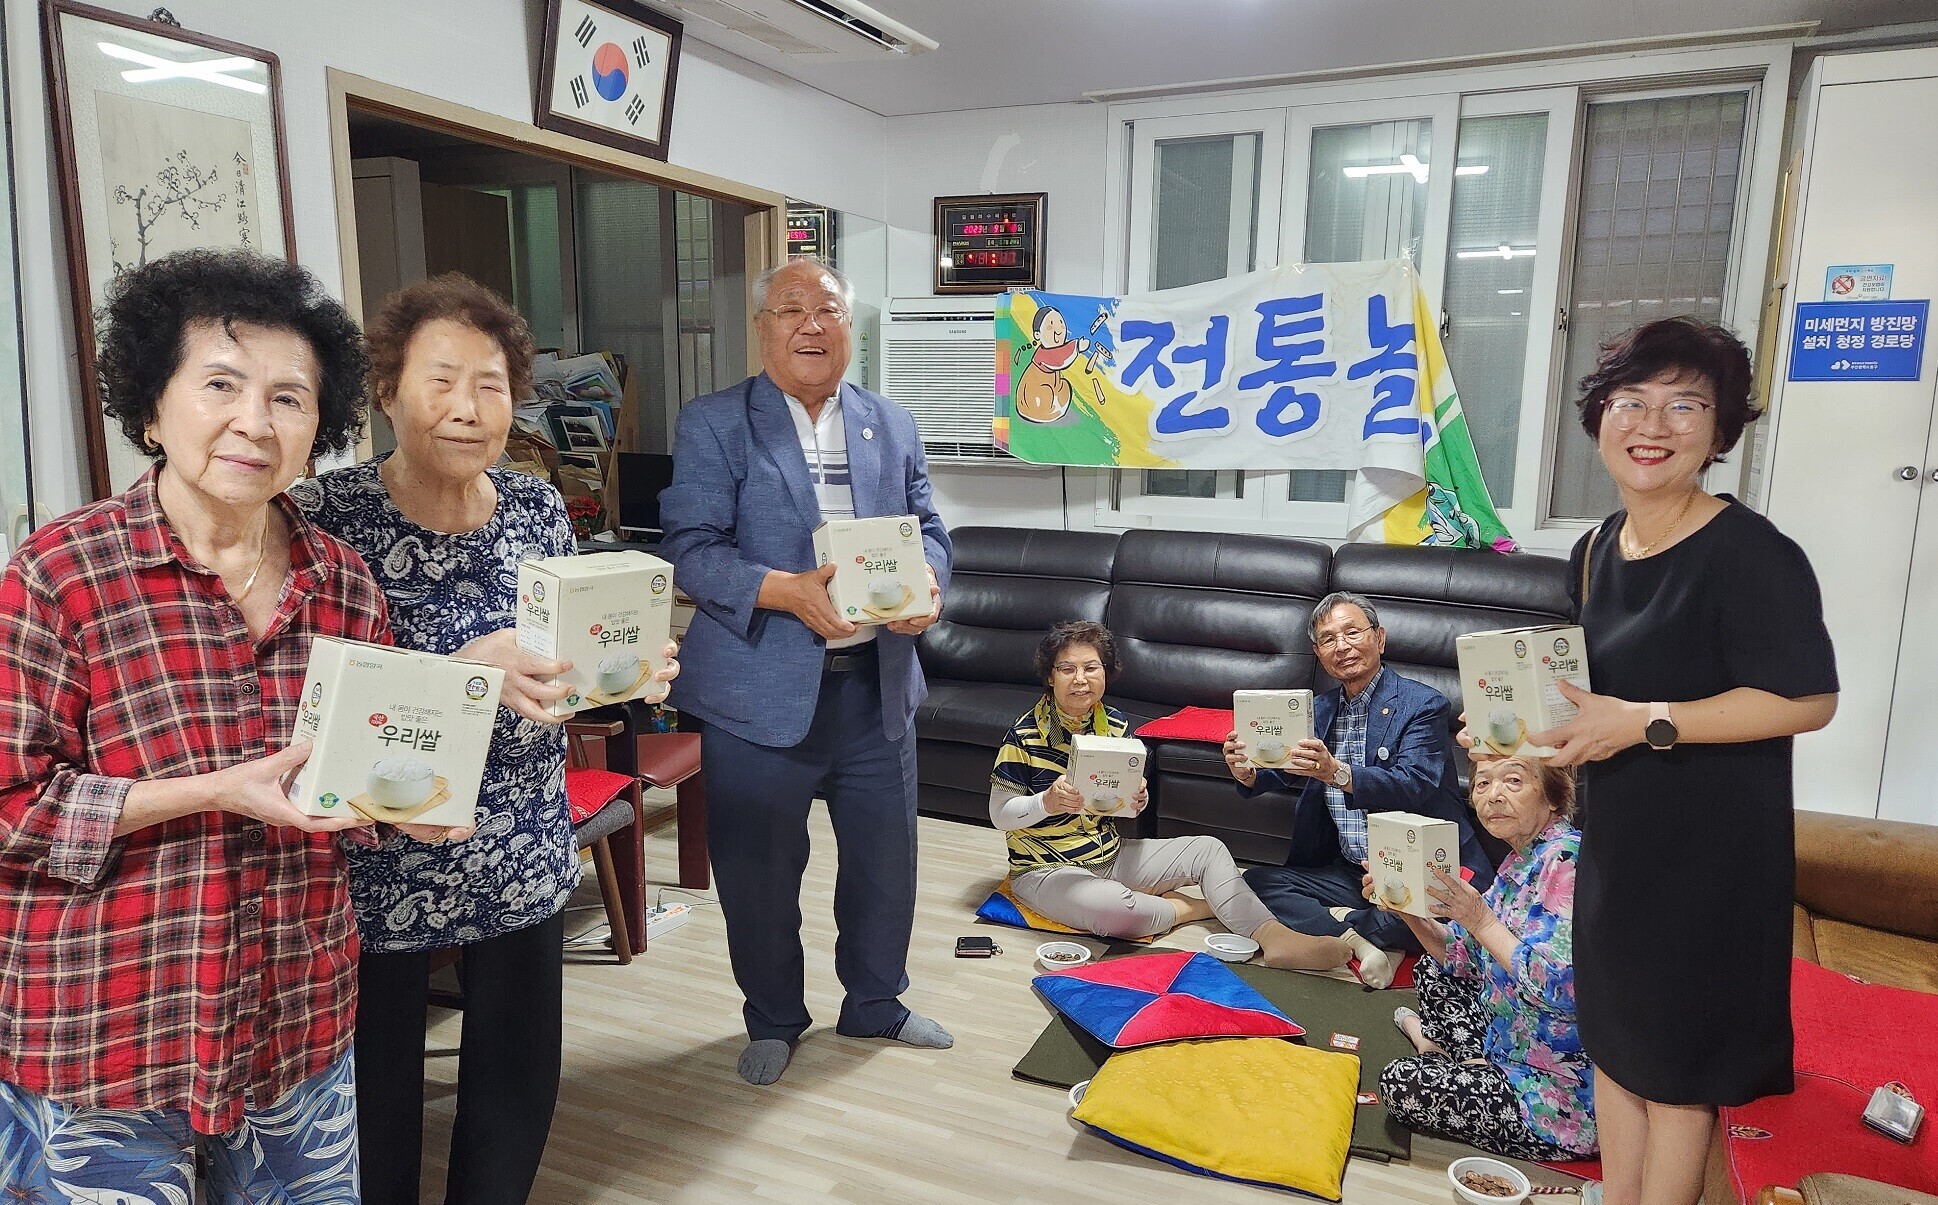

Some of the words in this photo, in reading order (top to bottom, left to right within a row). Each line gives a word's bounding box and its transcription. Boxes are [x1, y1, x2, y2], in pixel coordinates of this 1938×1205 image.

[1804, 316, 1866, 332] 미세먼지
[1870, 315, 1918, 332] 방진망
[1802, 334, 1832, 350] 설치
[1835, 334, 1866, 350] 청정
[1870, 334, 1916, 349] 경로당
[863, 559, 898, 575] 우리쌀
[526, 602, 551, 624] 우리쌀
[598, 625, 641, 649] 우리쌀
[1548, 658, 1580, 673] 우리쌀
[1484, 684, 1514, 702] 우리쌀
[301, 709, 321, 732] 우리쌀
[377, 724, 443, 752] 우리쌀
[1255, 725, 1284, 736] 우리쌀
[1093, 778, 1120, 789] 우리쌀
[1382, 856, 1404, 873] 우리쌀
